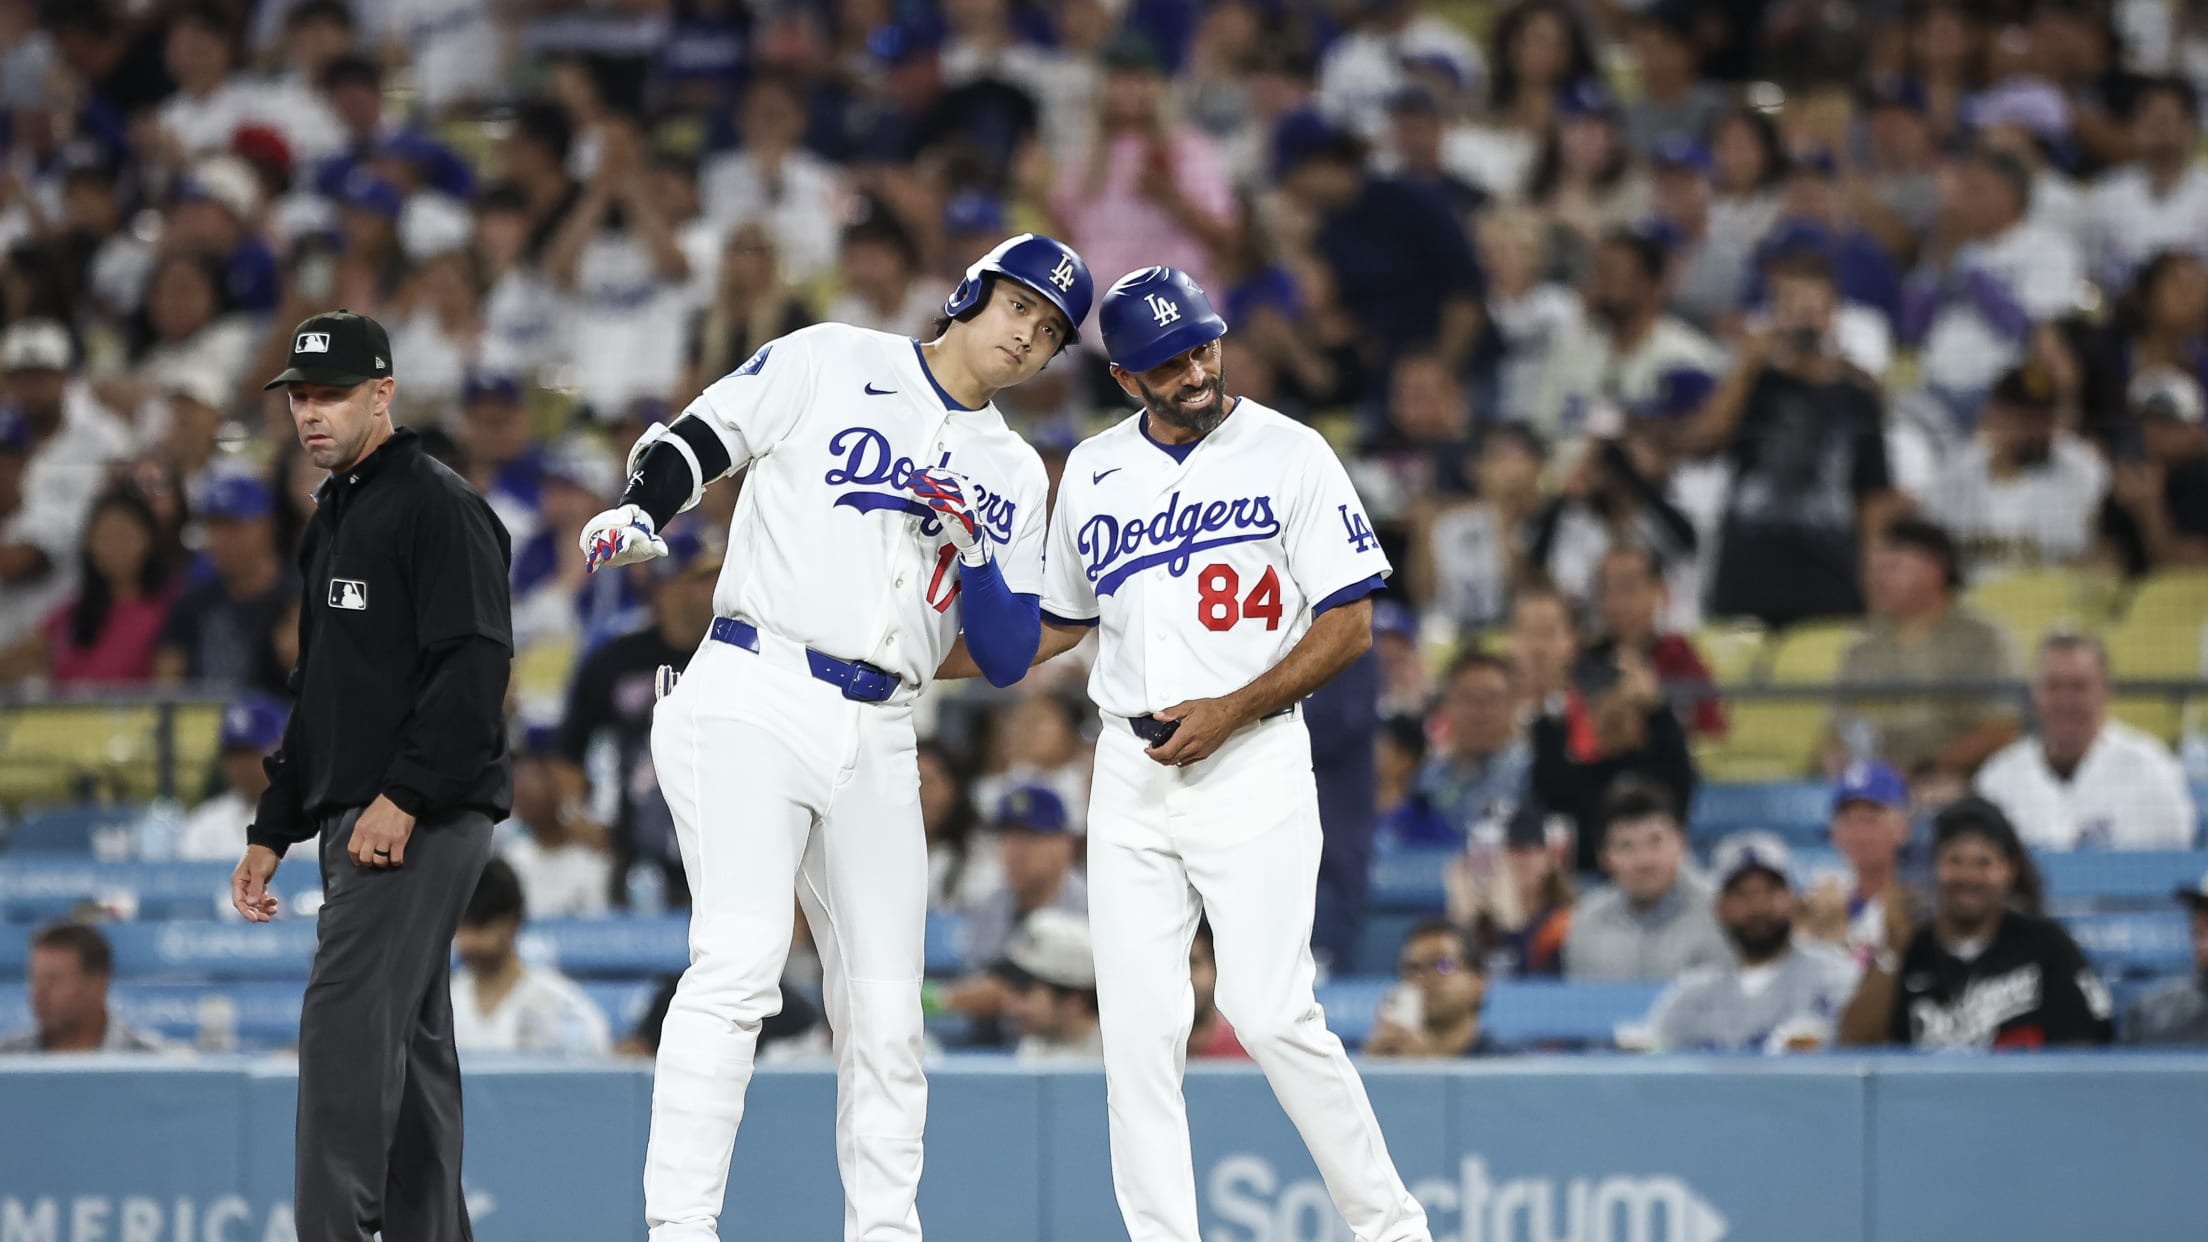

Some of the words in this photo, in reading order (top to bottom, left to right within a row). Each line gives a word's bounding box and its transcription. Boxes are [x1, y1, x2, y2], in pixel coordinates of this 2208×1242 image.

[1049, 253, 1075, 292] LA
[1144, 294, 1181, 327] LA
[825, 427, 1016, 544] Doers
[1078, 491, 1280, 597] Dodgers
[1338, 505, 1379, 553] LA
[1198, 564, 1283, 631] 84
